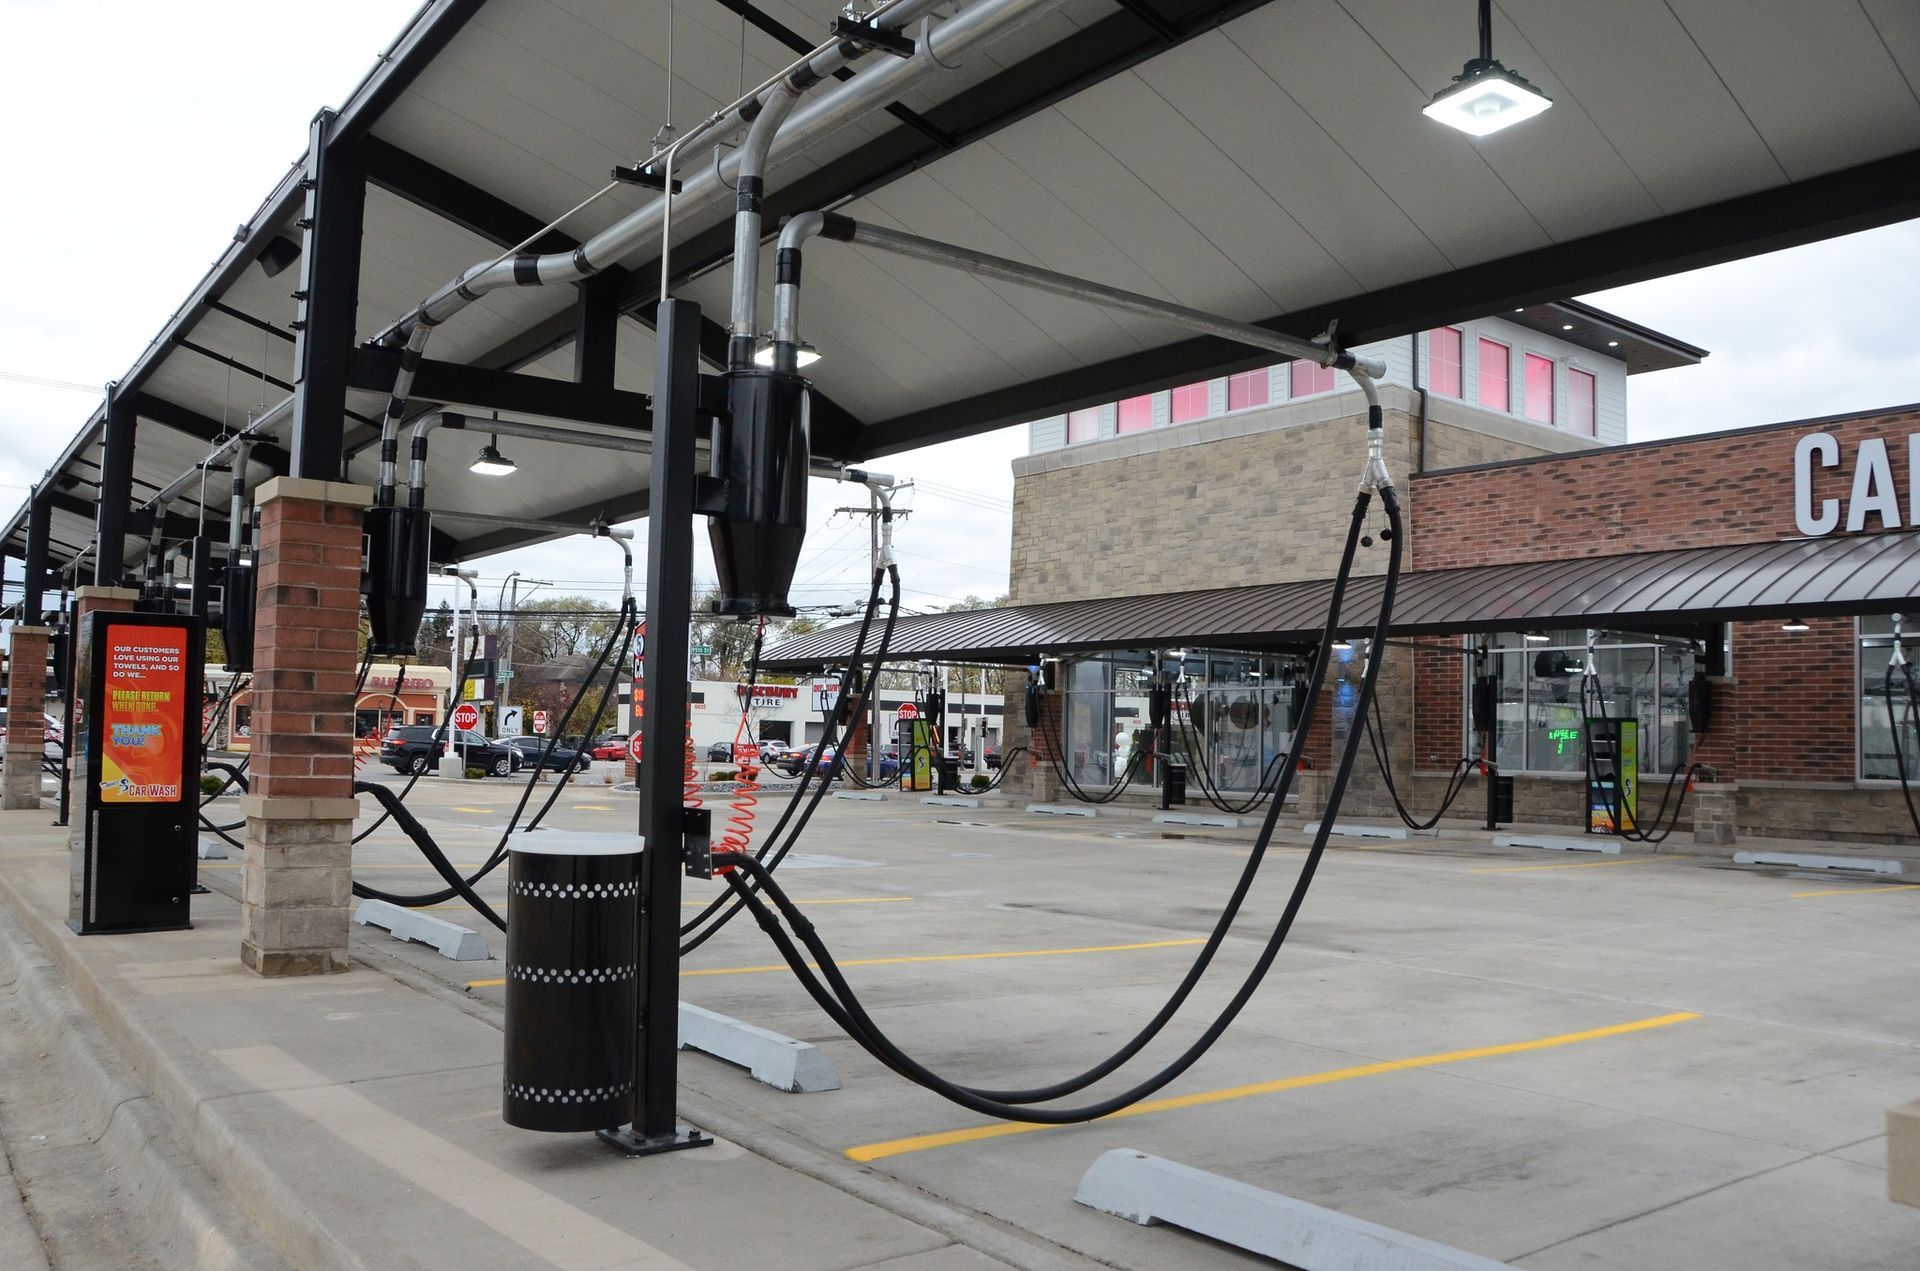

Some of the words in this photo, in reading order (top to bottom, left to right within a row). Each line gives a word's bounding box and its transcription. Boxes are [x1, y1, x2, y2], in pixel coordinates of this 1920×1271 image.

[1795, 432, 1920, 536] CA
[112, 690, 140, 700] PLEASE
[141, 691, 171, 702] RETURN
[112, 701, 136, 711] WHEN
[754, 698, 781, 706] TIRE
[455, 712, 477, 723] STOP
[899, 710, 917, 719] STOP
[112, 724, 162, 735] THANK
[112, 736, 145, 746] YOU!
[129, 785, 147, 796] CAR
[149, 785, 176, 796] WASH
